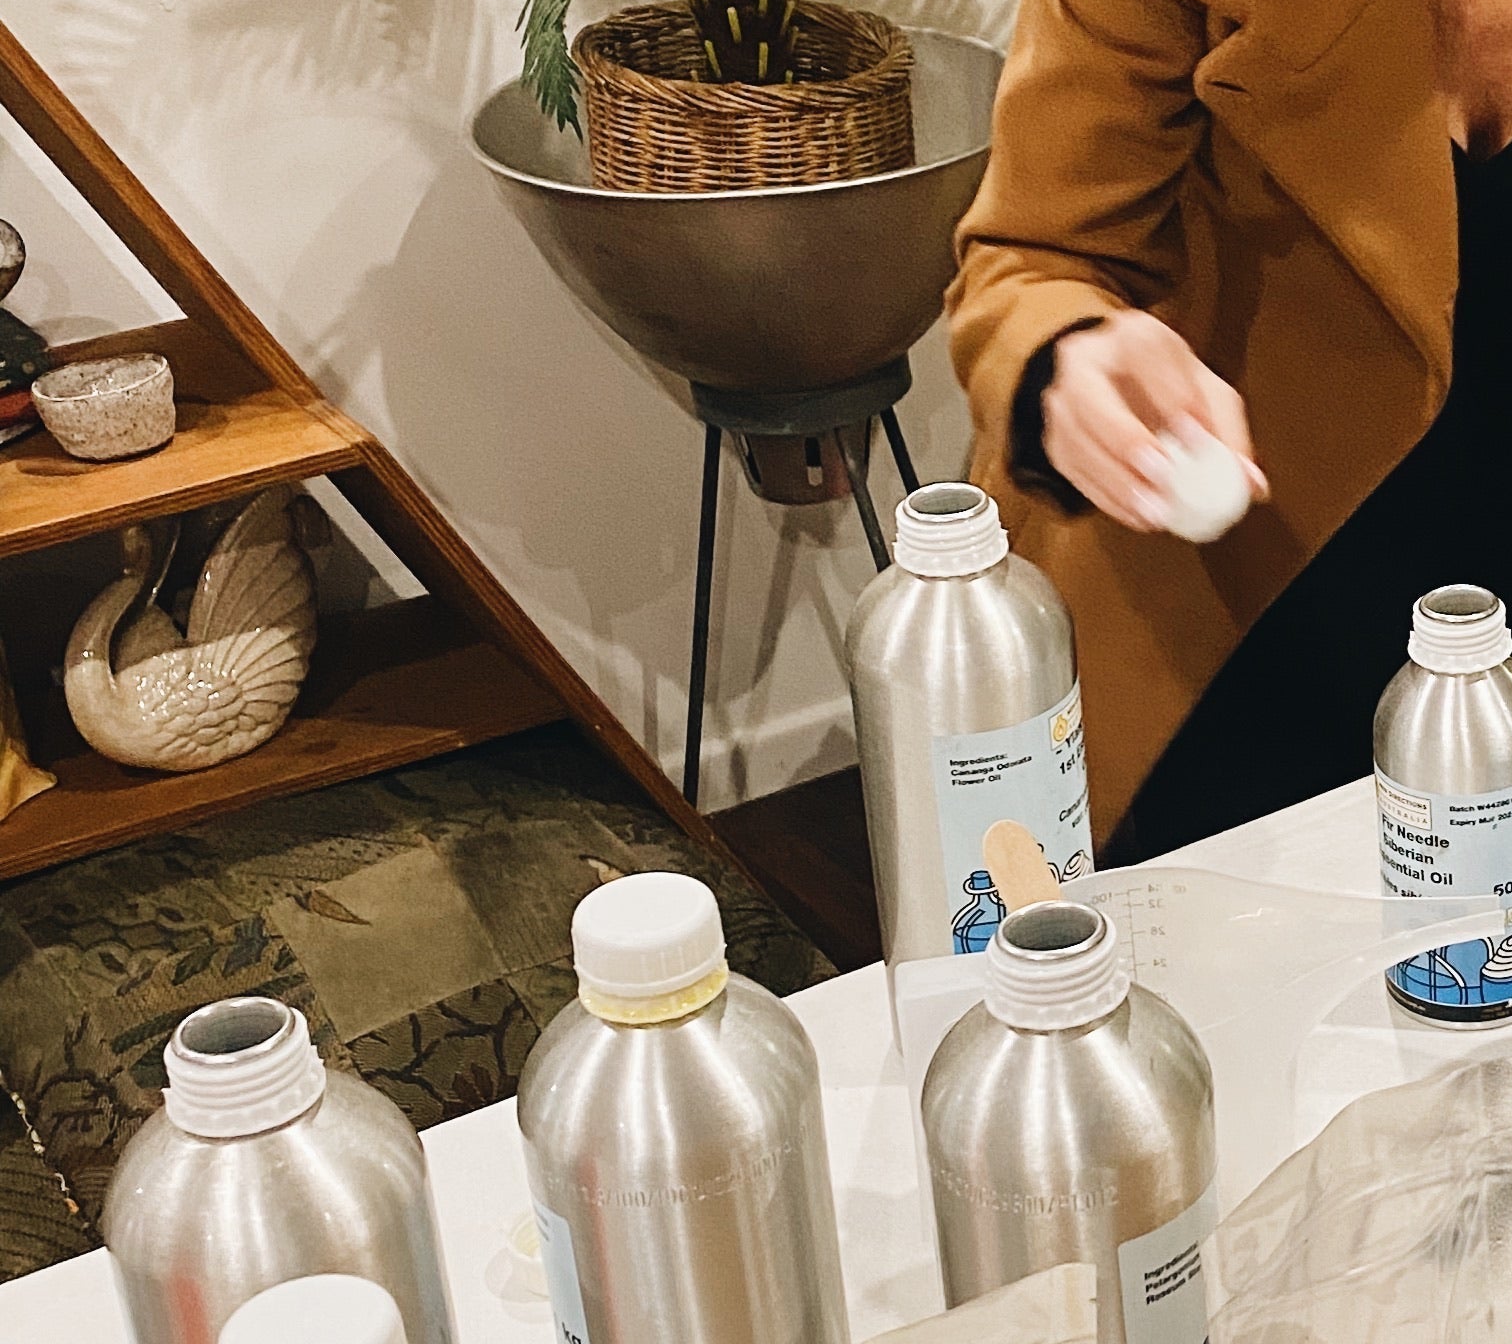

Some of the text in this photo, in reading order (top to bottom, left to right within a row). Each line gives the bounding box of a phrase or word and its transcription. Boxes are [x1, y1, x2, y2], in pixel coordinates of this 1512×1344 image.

[1382, 813, 1450, 849] Fir Needle
[1449, 819, 1477, 827] Expiry
[1384, 832, 1435, 865] Siberian
[1430, 871, 1453, 886] Oil
